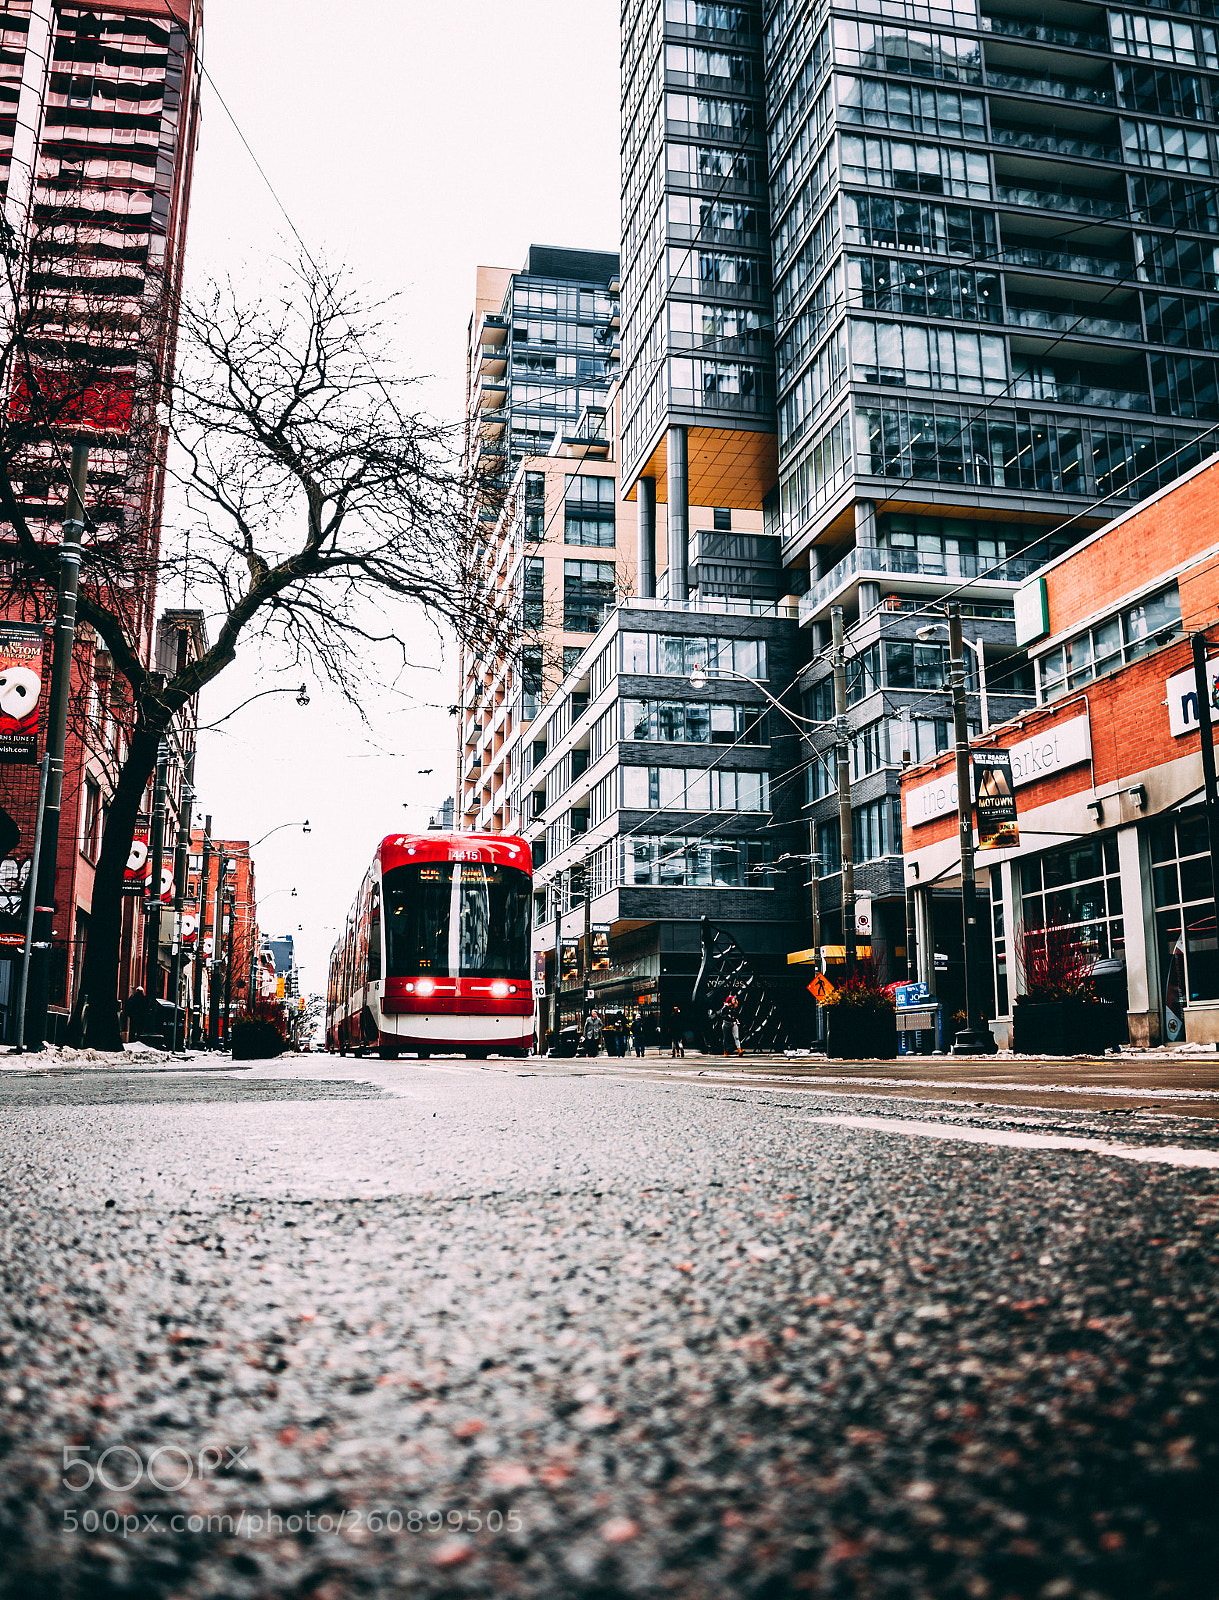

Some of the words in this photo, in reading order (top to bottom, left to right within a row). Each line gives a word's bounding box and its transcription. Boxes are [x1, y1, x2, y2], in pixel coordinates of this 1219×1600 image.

[923, 786, 946, 816] the
[1012, 734, 1061, 780] arket
[978, 797, 1013, 808] MOTOWN
[452, 850, 478, 860] 4415
